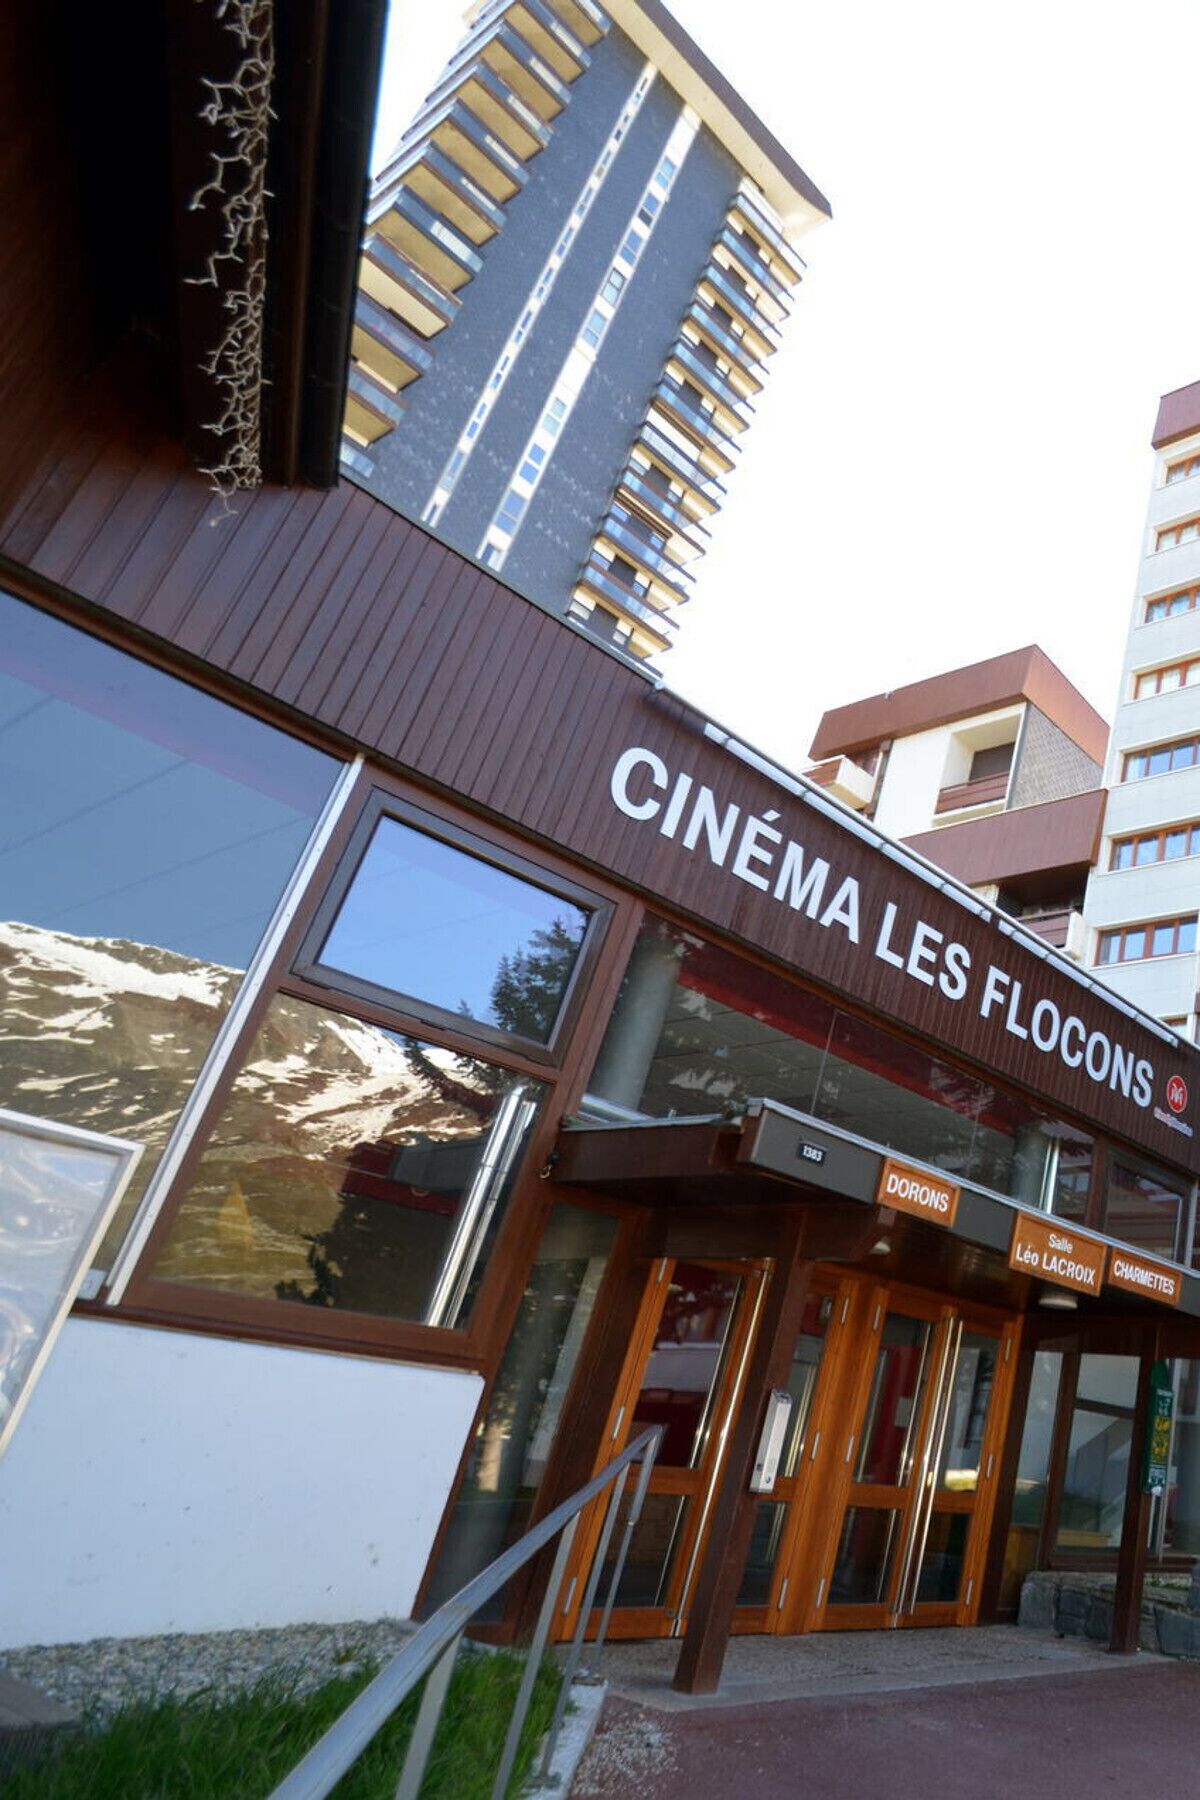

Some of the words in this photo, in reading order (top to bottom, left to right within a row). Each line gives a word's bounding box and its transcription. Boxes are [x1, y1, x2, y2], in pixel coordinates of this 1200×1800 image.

[611, 747, 859, 944] CINÉMA
[875, 902, 971, 1000] LES
[980, 965, 1154, 1108] FLOCONS
[803, 1145, 822, 1161] 1383
[886, 1173, 949, 1212] DORONS
[1048, 1234, 1073, 1254] Salle
[1016, 1243, 1039, 1265] Léo
[1042, 1252, 1096, 1285] LACROIX
[1114, 1260, 1175, 1295] CHARMETTES
